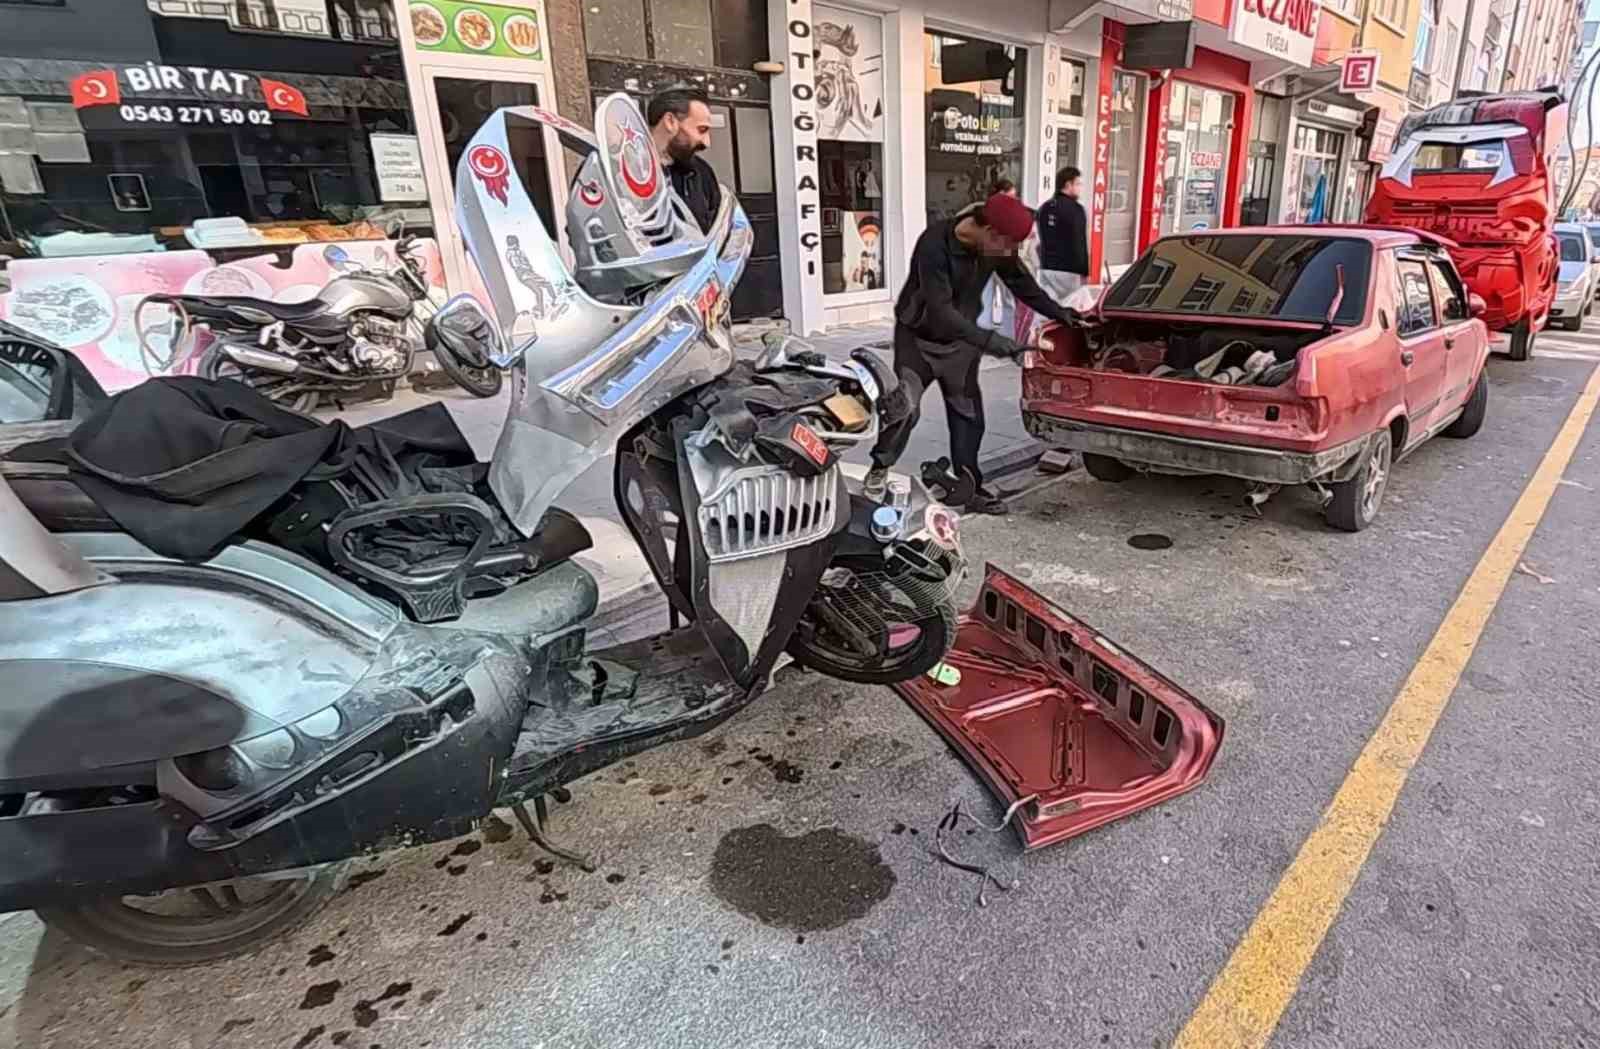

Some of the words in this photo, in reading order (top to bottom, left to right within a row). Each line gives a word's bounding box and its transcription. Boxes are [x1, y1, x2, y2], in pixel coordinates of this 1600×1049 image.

[124, 60, 184, 92] BİR
[187, 66, 249, 95] TAT
[1350, 63, 1367, 82] E
[120, 105, 173, 122] 0543
[177, 106, 214, 123] 271
[219, 108, 244, 124] 50
[248, 109, 273, 125] 02
[788, 0, 819, 275] OTOĞRAFÇI
[1094, 95, 1110, 233] ECZANE
[1152, 105, 1168, 230] ECZANE
